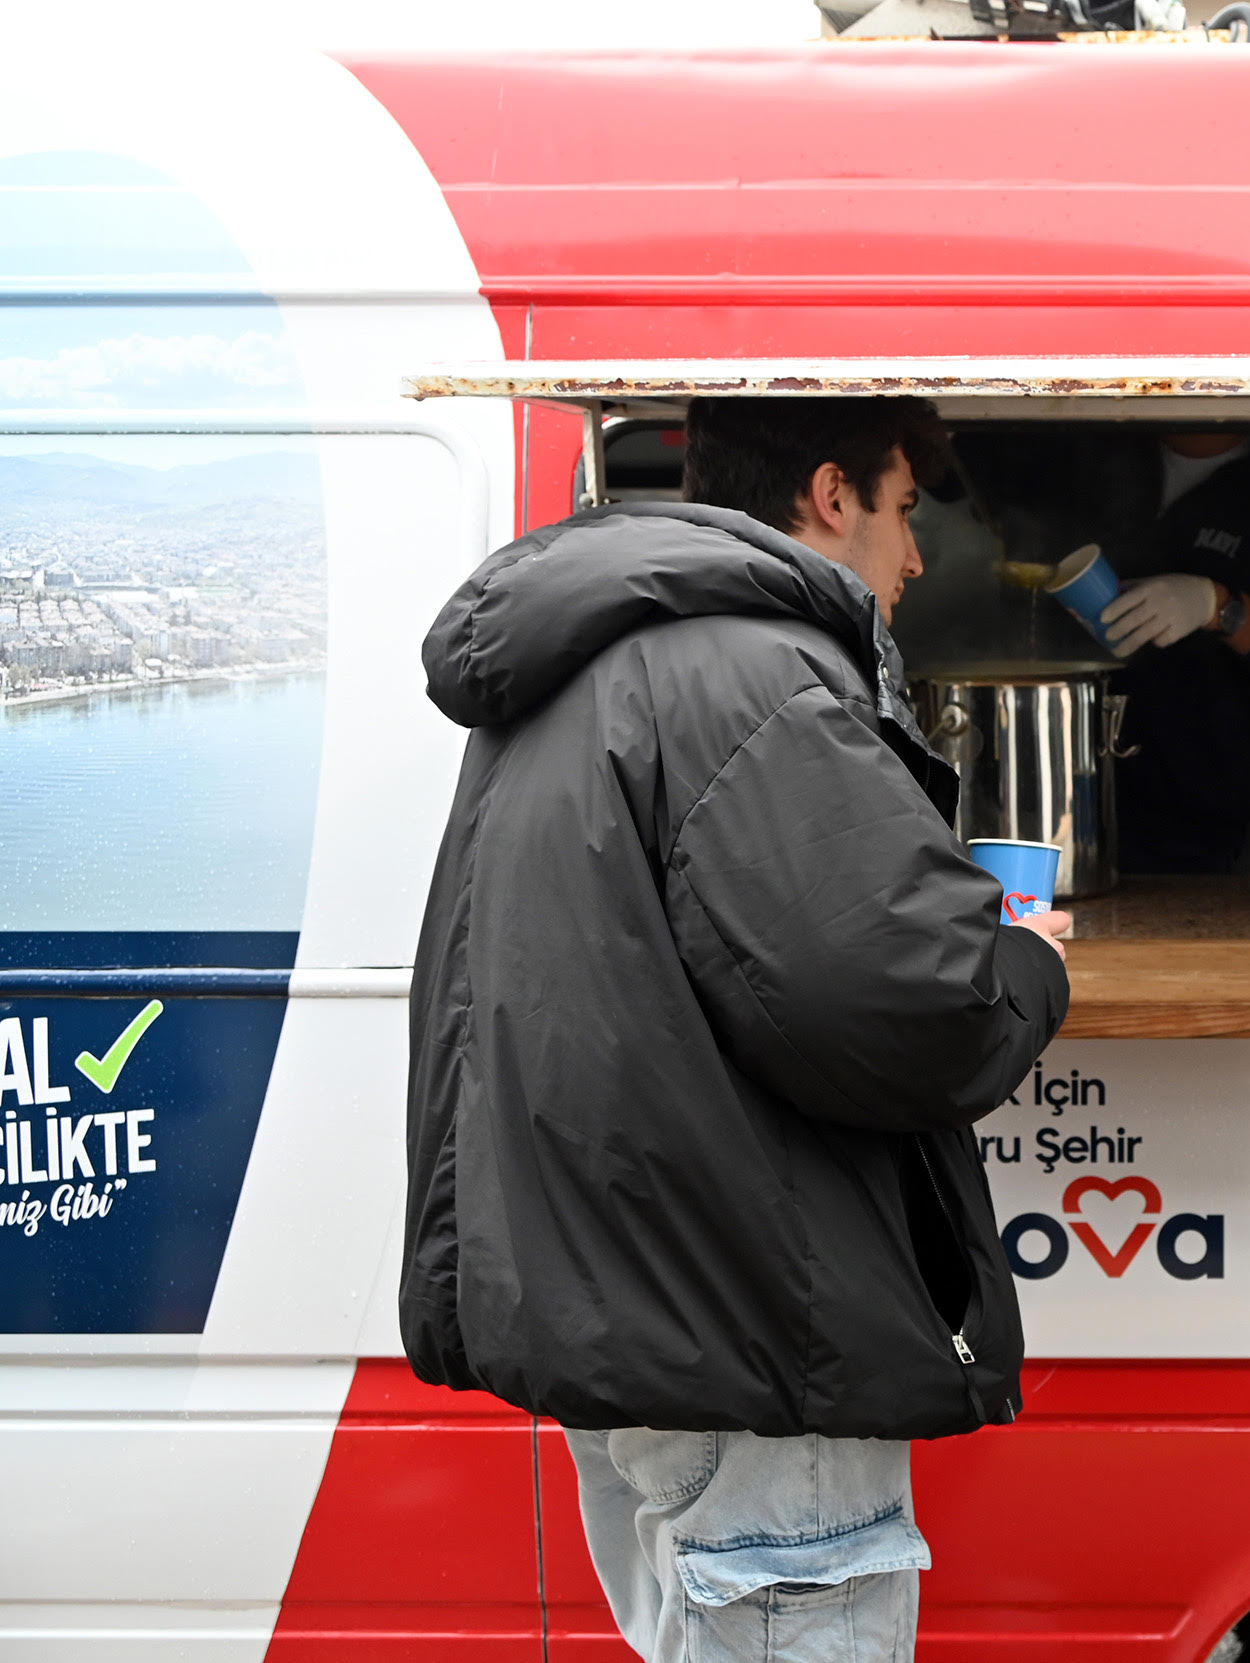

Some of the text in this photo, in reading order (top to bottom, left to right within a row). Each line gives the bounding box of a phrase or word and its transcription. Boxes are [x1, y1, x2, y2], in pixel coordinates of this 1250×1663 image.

[1034, 1060, 1105, 1116] İçin
[0, 1107, 157, 1185] İLİKTE
[976, 1126, 1142, 1174] ru Şehir
